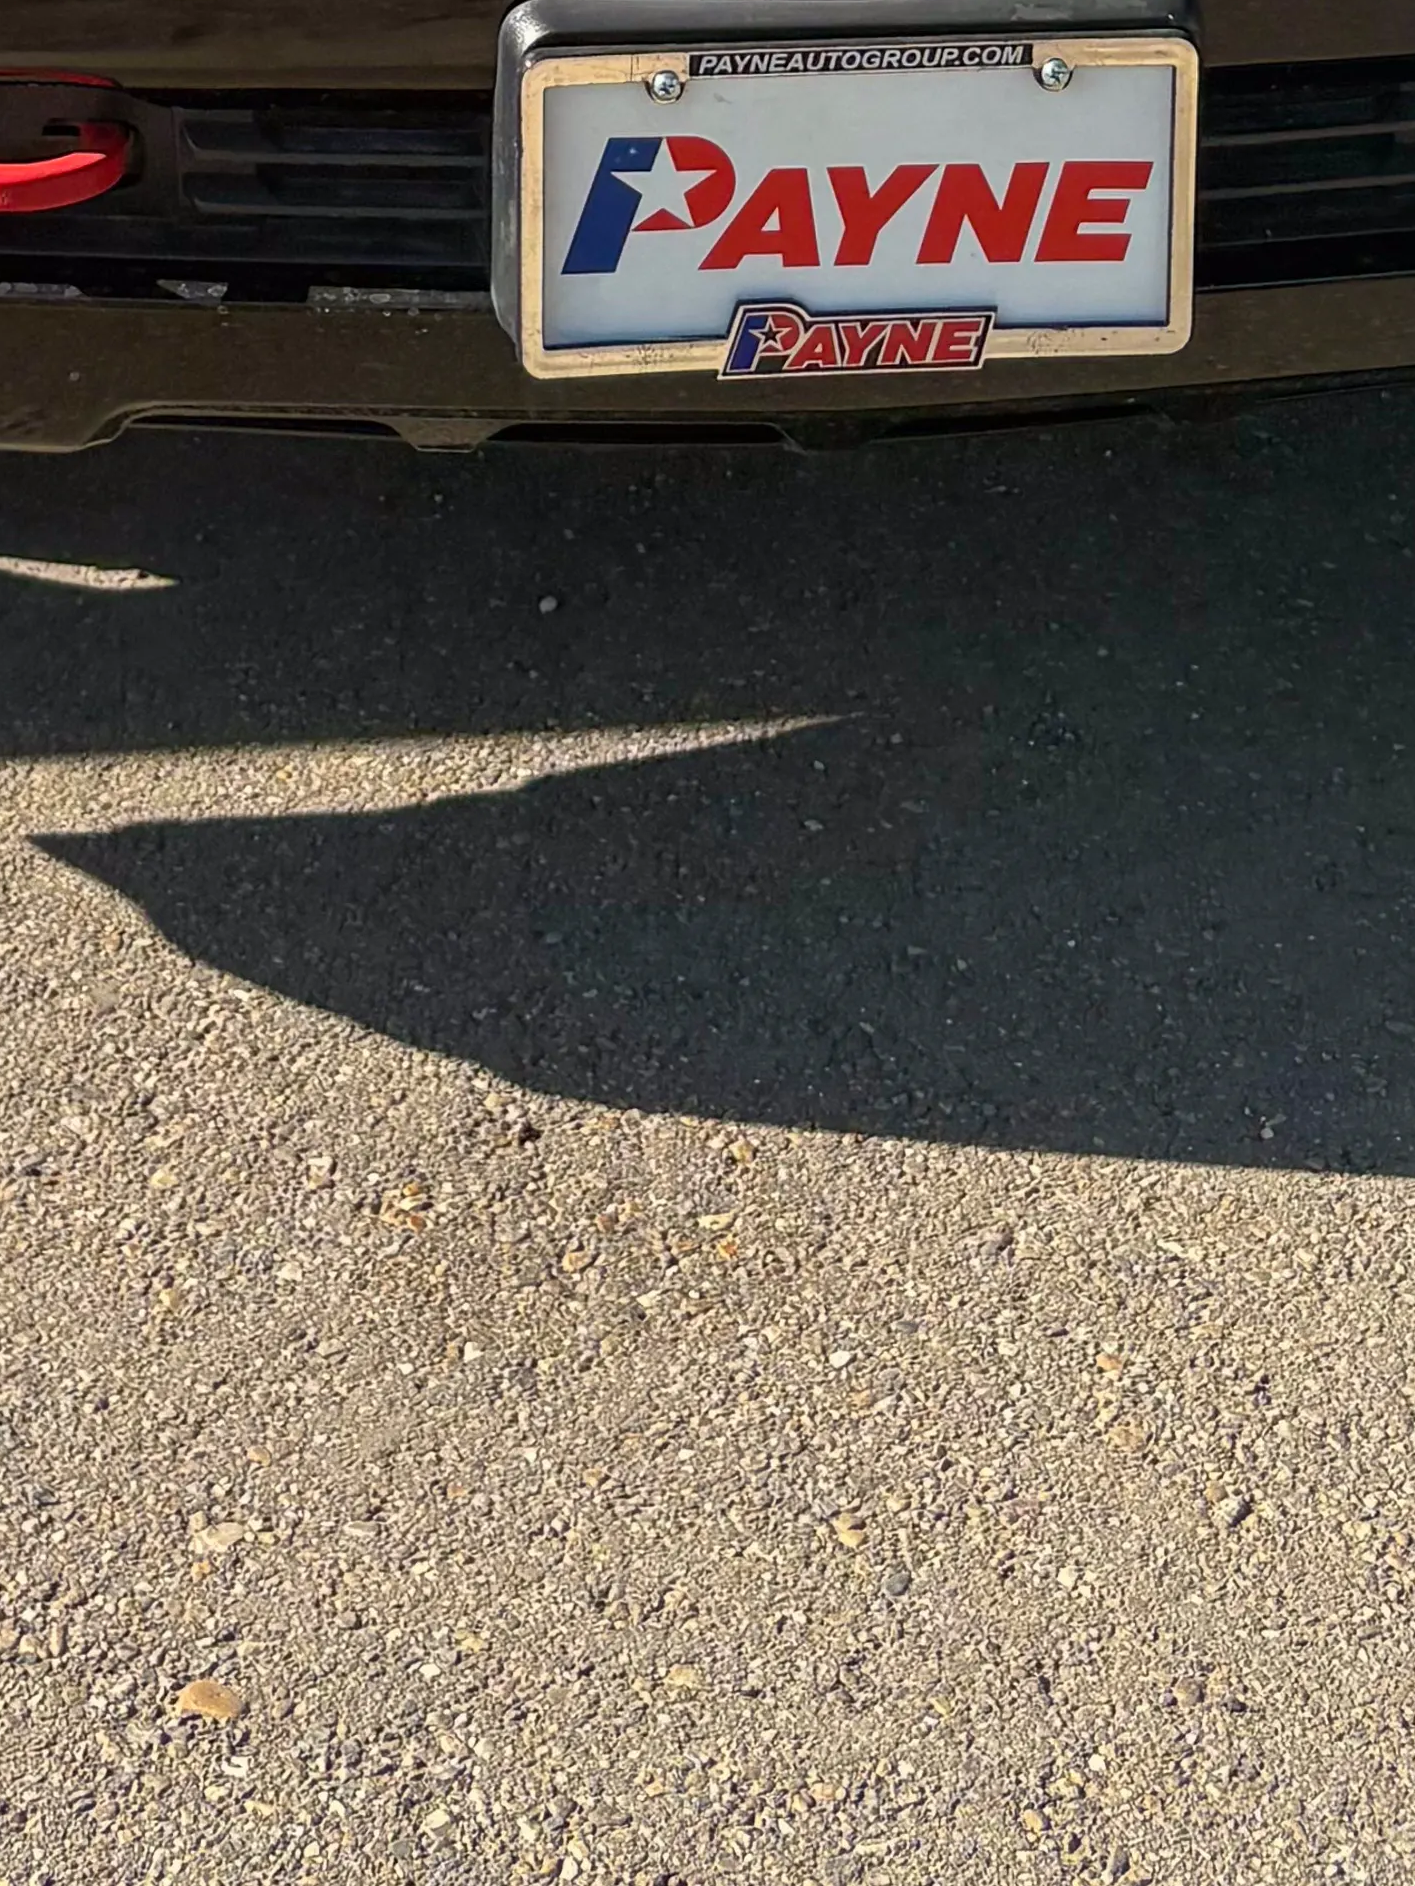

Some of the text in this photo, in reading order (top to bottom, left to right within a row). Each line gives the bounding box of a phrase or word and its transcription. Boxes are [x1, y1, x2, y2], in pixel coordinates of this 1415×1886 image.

[697, 45, 1025, 76] PAYNEAUTOGROUP.COM
[561, 134, 1154, 275] PAYNE
[725, 310, 986, 374] PAYNE
